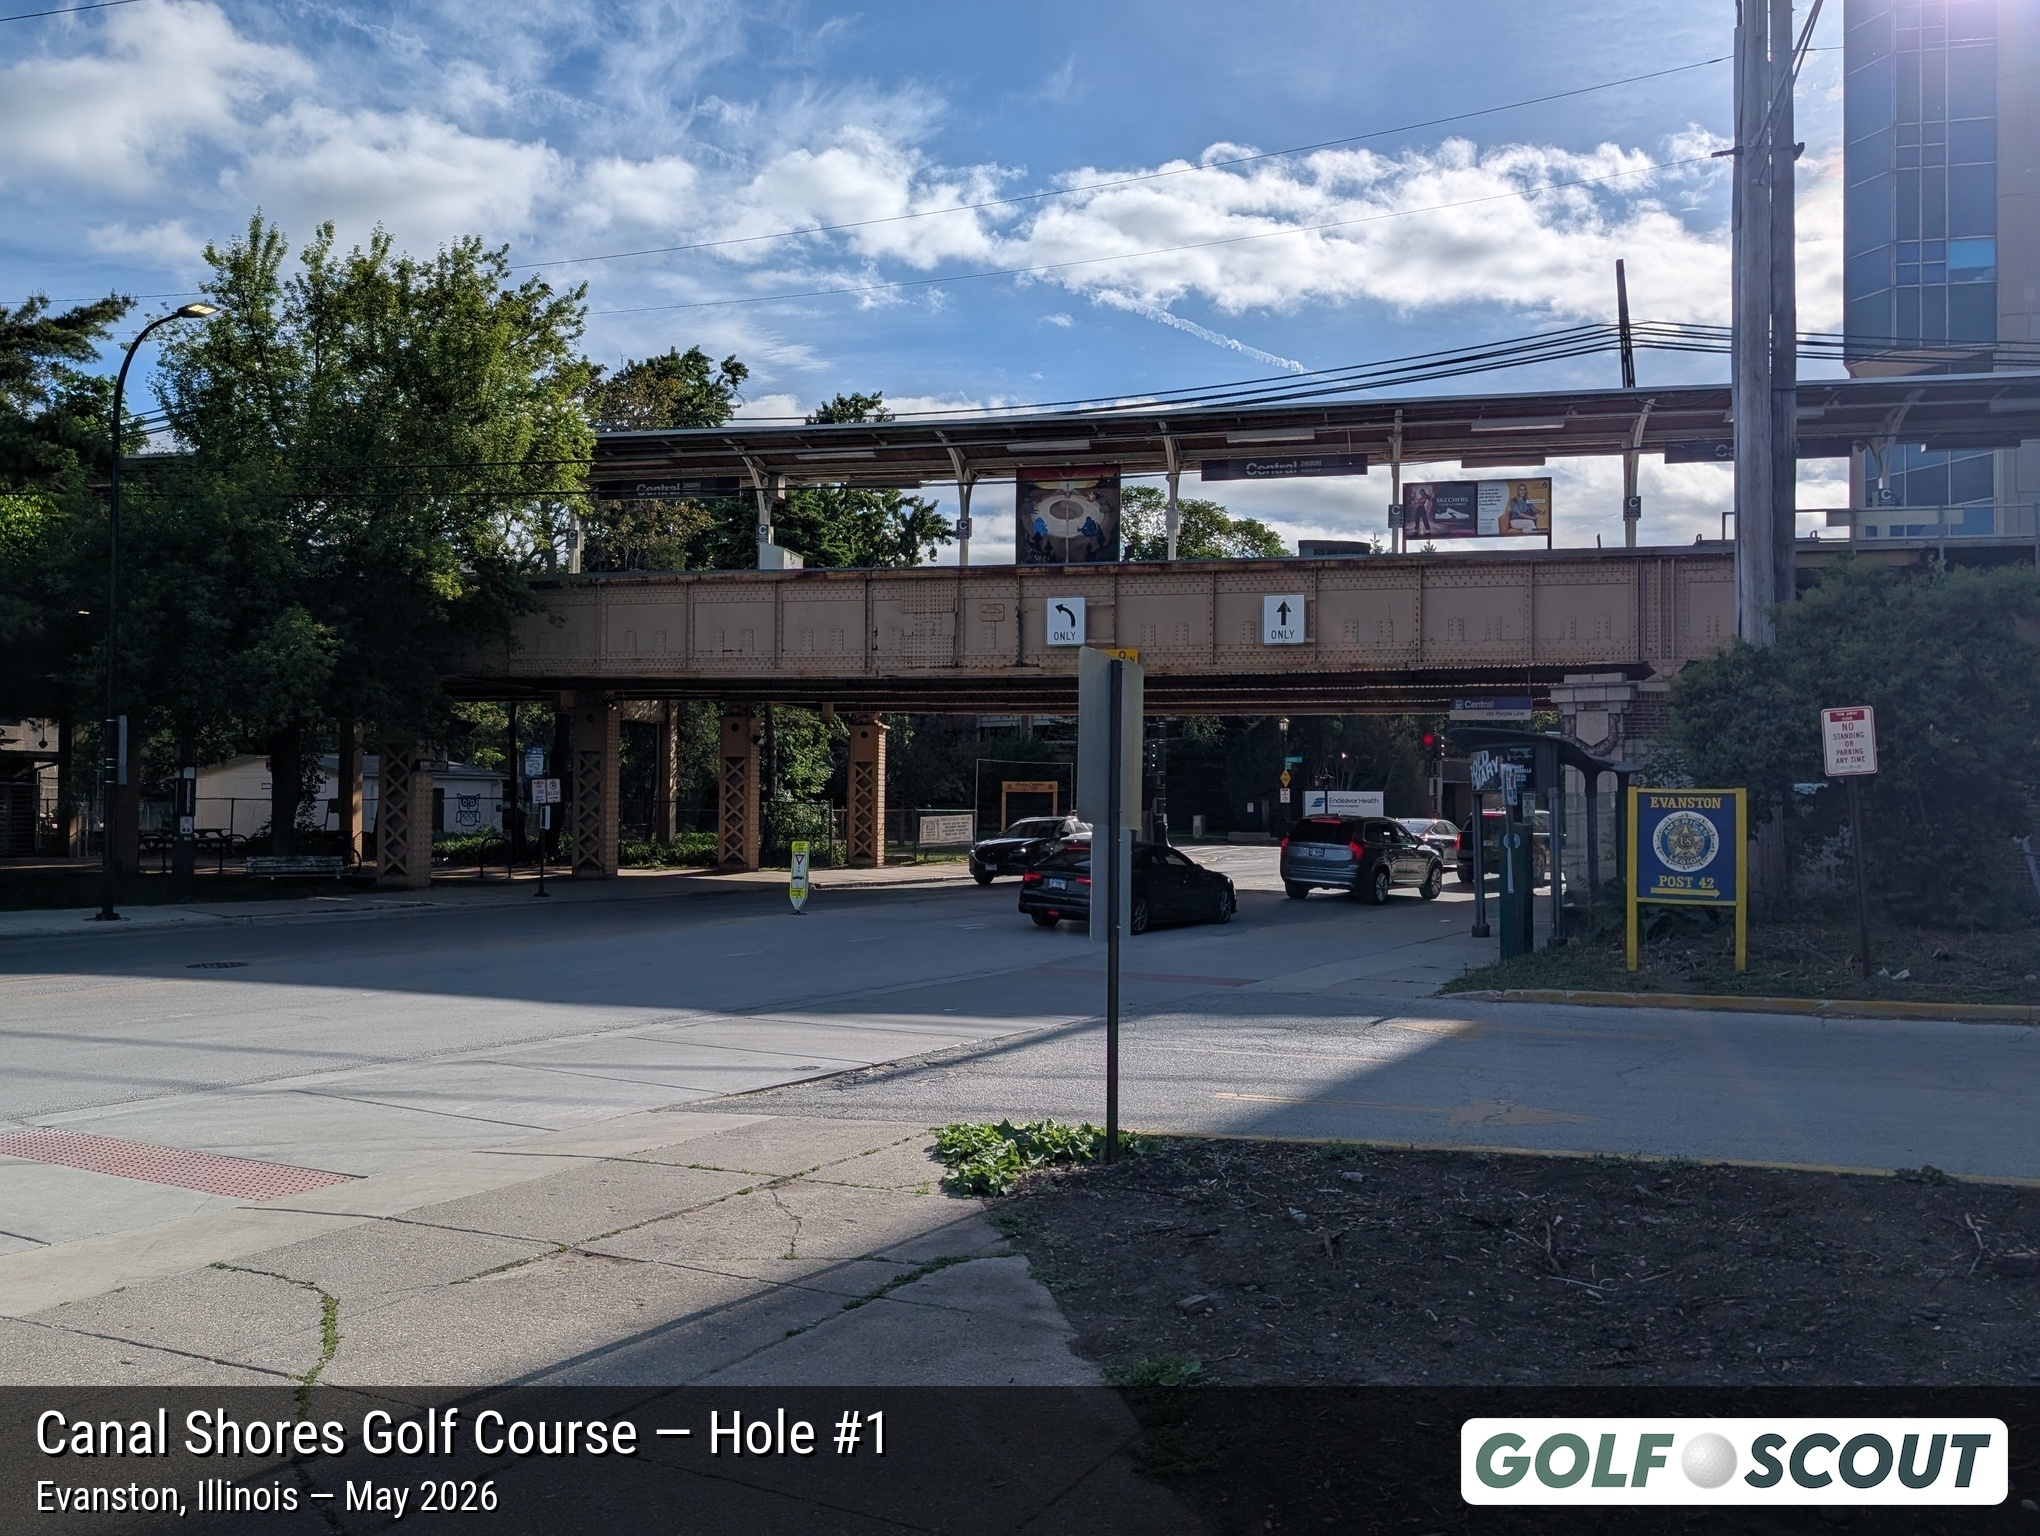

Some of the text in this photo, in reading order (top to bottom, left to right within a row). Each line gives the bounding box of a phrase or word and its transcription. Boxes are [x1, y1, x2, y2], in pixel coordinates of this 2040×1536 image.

[1245, 461, 1297, 476] Central
[636, 483, 680, 496] Central
[1881, 489, 1892, 500] C
[1436, 496, 1469, 504] SKECHERS
[1628, 497, 1638, 508] C
[1391, 505, 1401, 515] C
[758, 525, 767, 535] C
[959, 520, 968, 530] C
[568, 530, 576, 540] C
[1053, 631, 1077, 641] ONLY
[1271, 629, 1295, 640] ONLY
[1464, 700, 1494, 709] Central
[1841, 722, 1854, 732] NO
[1832, 731, 1865, 741] STANDING
[1844, 740, 1854, 748] OR
[1836, 747, 1864, 757] PARKING
[1835, 755, 1866, 765] ANY TIME
[1650, 796, 1721, 809] EVANSTON
[1663, 819, 1709, 837] AMERICAN
[1669, 853, 1703, 866] LEGION
[1658, 875, 1714, 889] POST 42
